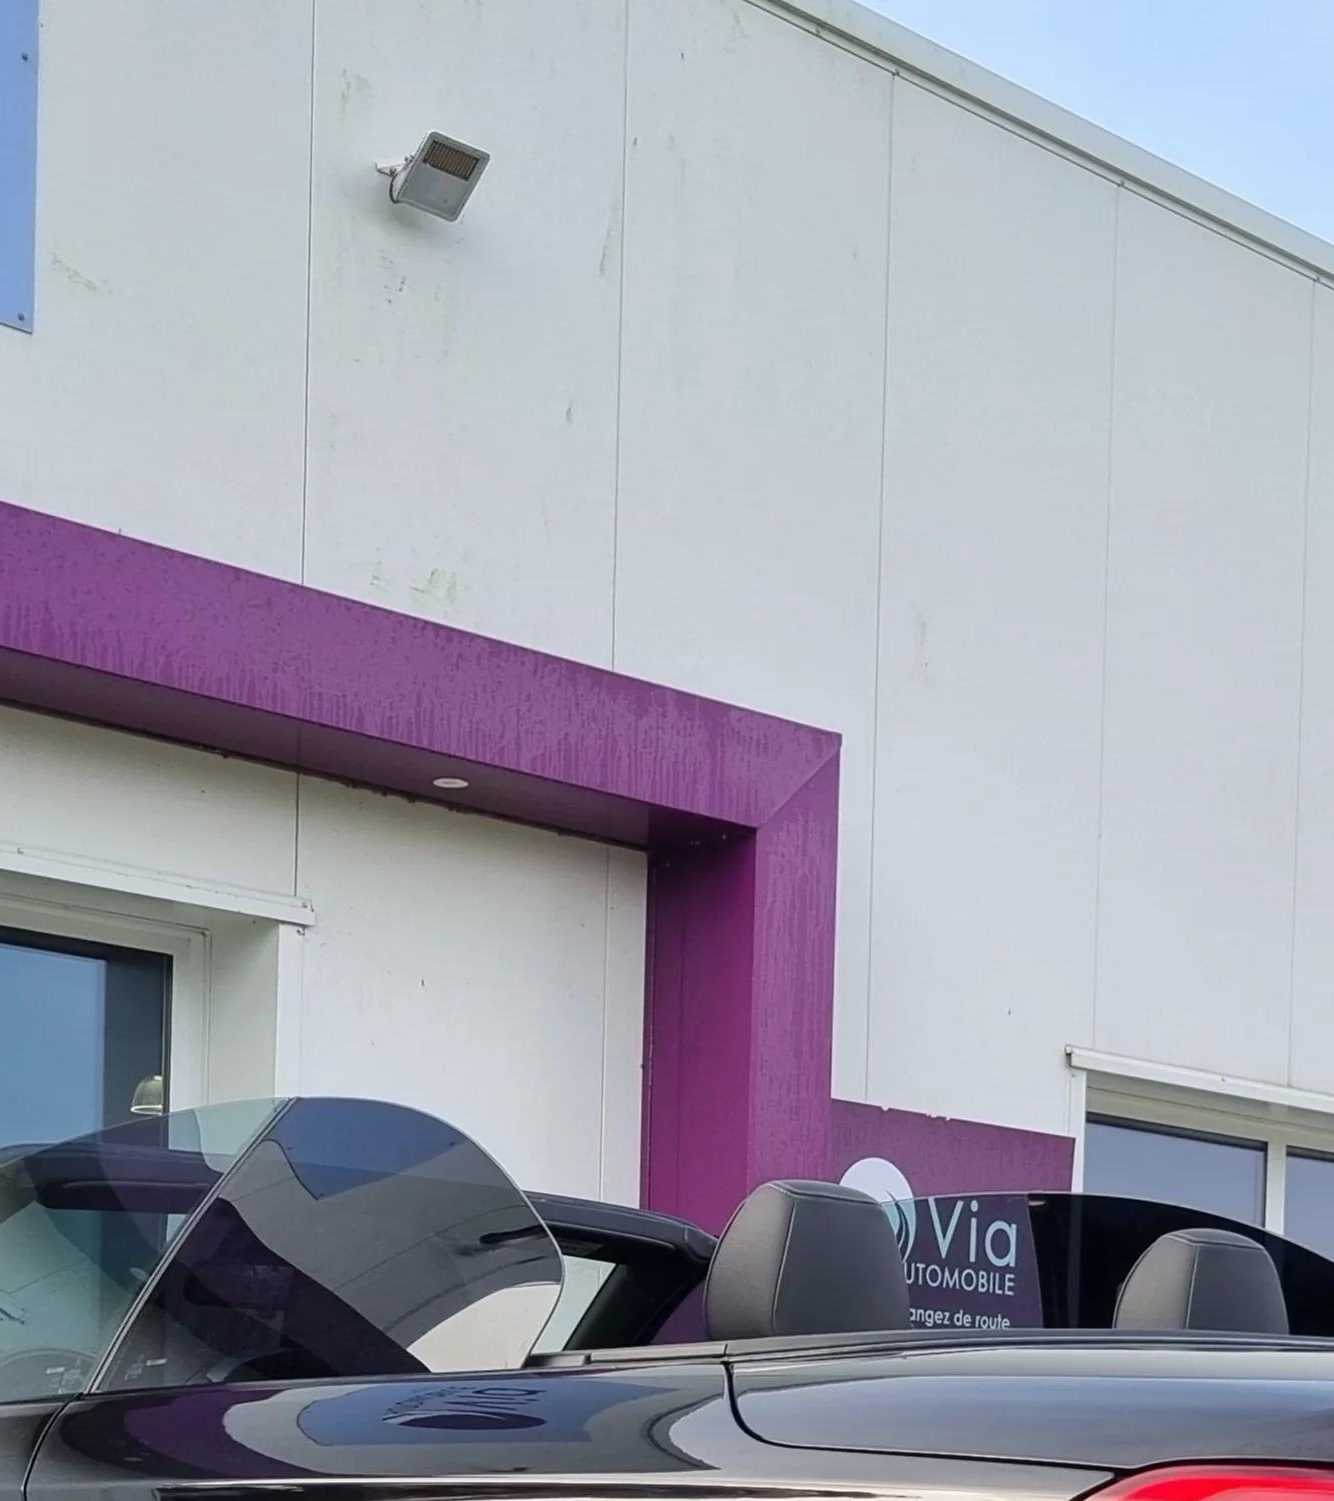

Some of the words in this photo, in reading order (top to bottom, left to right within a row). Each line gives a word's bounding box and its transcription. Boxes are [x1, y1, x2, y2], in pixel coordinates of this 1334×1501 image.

[927, 1198, 1017, 1267] Via
[903, 1262, 1015, 1295] UTOMOBILE
[953, 1310, 972, 1327] de
[975, 1314, 1011, 1330] route
